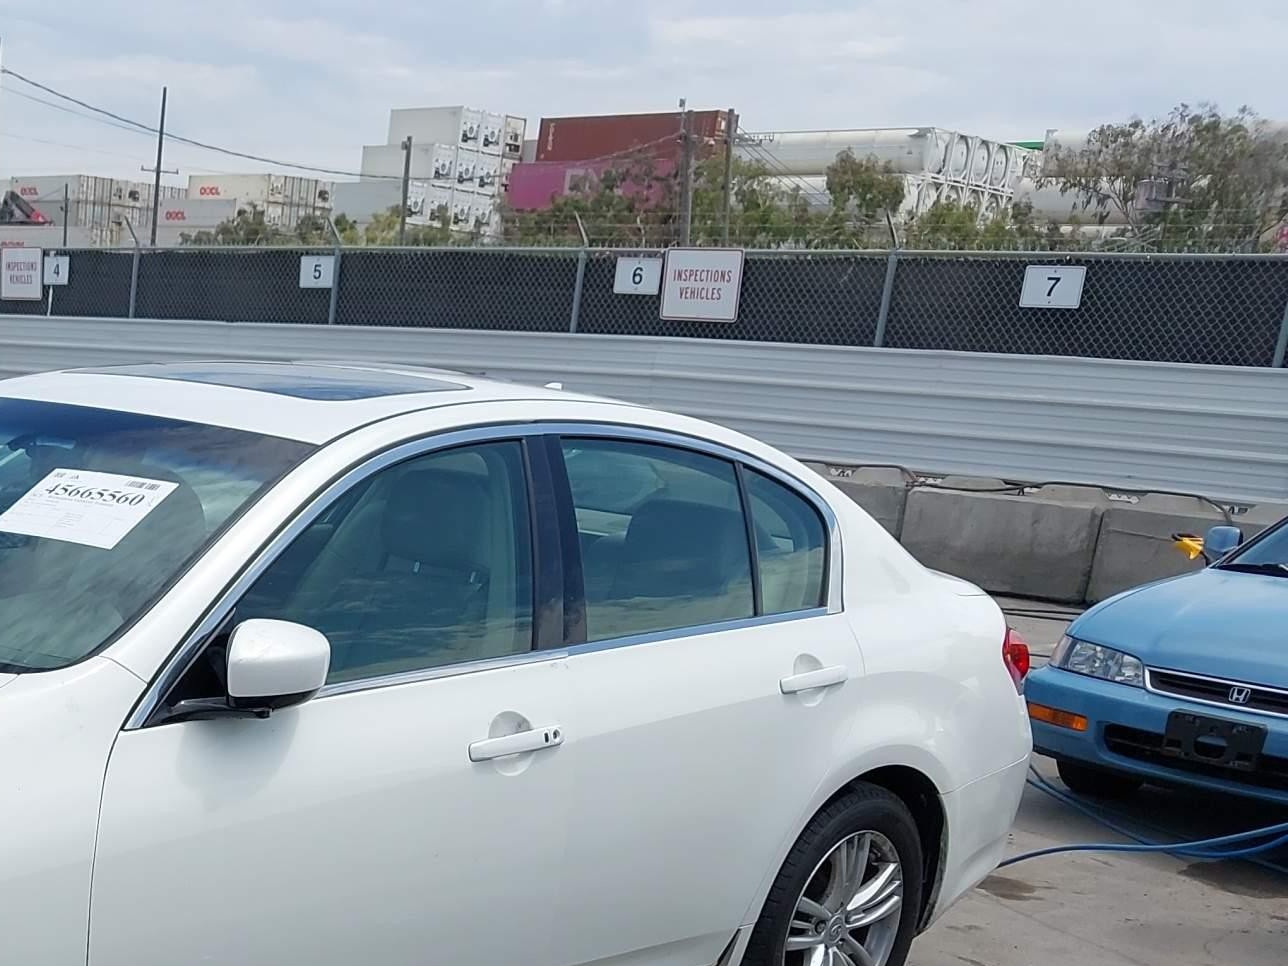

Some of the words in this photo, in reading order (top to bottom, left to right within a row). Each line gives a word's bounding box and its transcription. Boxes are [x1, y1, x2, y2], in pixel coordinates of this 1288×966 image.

[53, 263, 60, 278] 4
[313, 264, 322, 280] 5
[632, 266, 644, 285] 6
[673, 269, 732, 283] INSPECTIONS
[679, 287, 722, 301] VEHICLES
[1046, 276, 1061, 297] 7
[45, 482, 145, 506] 45665560
